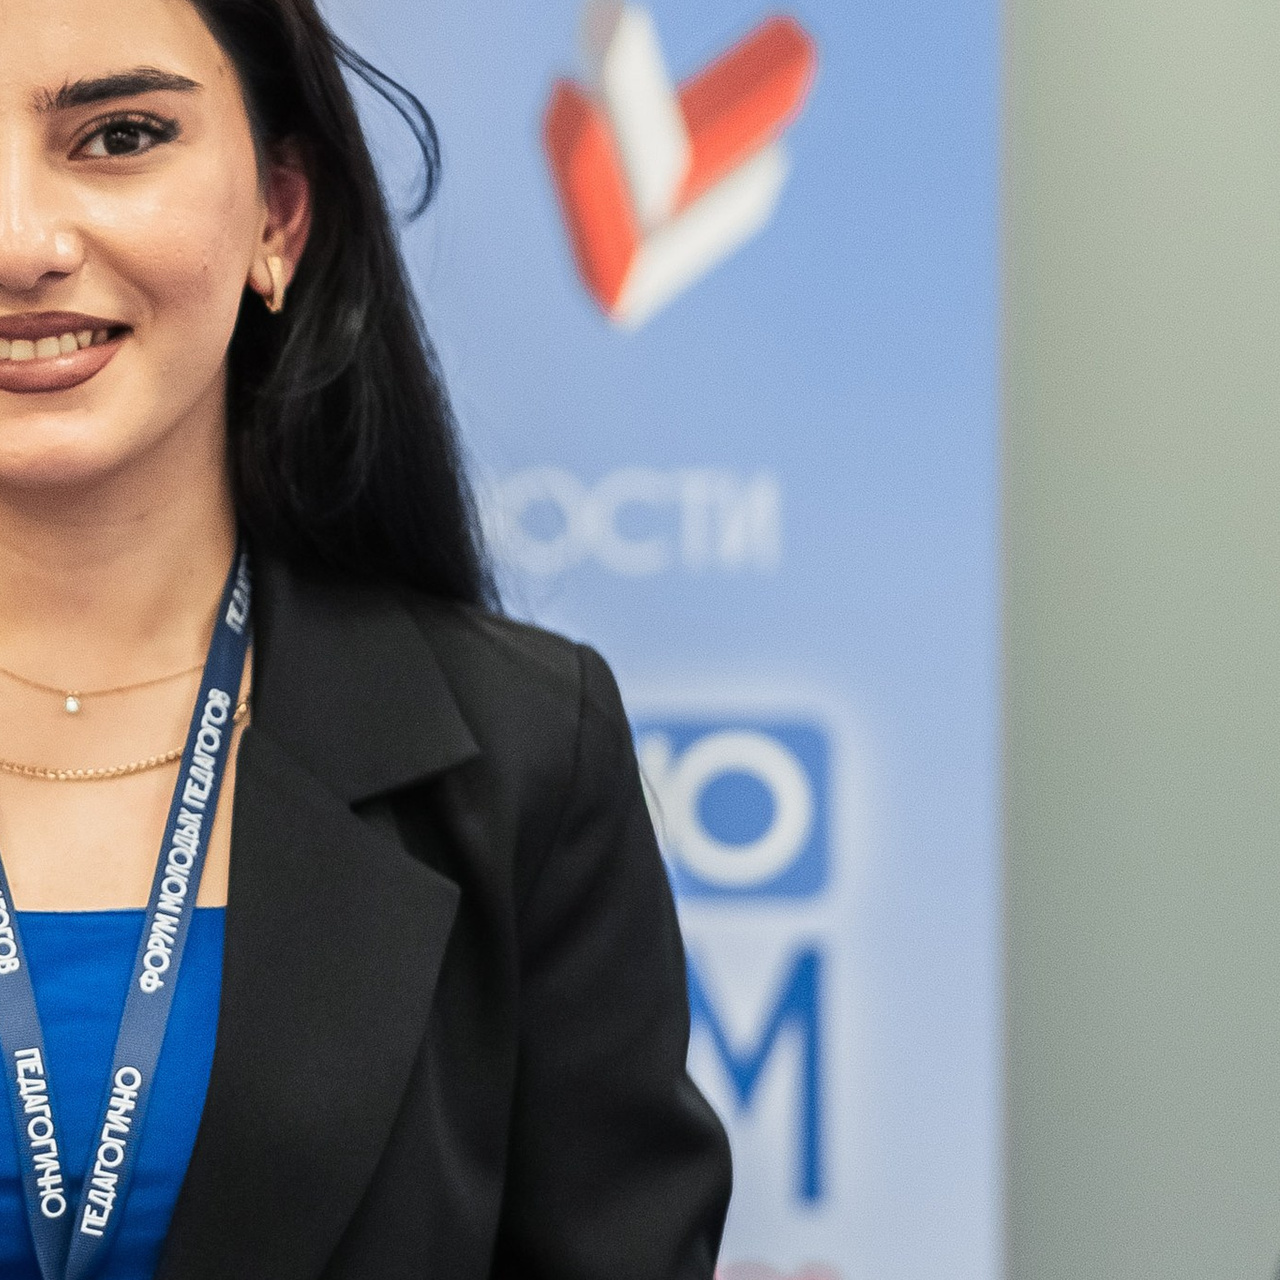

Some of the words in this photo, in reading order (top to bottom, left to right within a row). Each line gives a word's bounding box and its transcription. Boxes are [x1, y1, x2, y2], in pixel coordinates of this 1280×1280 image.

[182, 687, 233, 809] ПЕДАГОГОВ
[158, 808, 203, 915] МОЛОДЫХ
[139, 913, 179, 994] ФОРУМ
[14, 1047, 67, 1218] ПЕДАГОГИЧНО
[80, 1066, 142, 1237] ПЕДАГОГИЧНО
